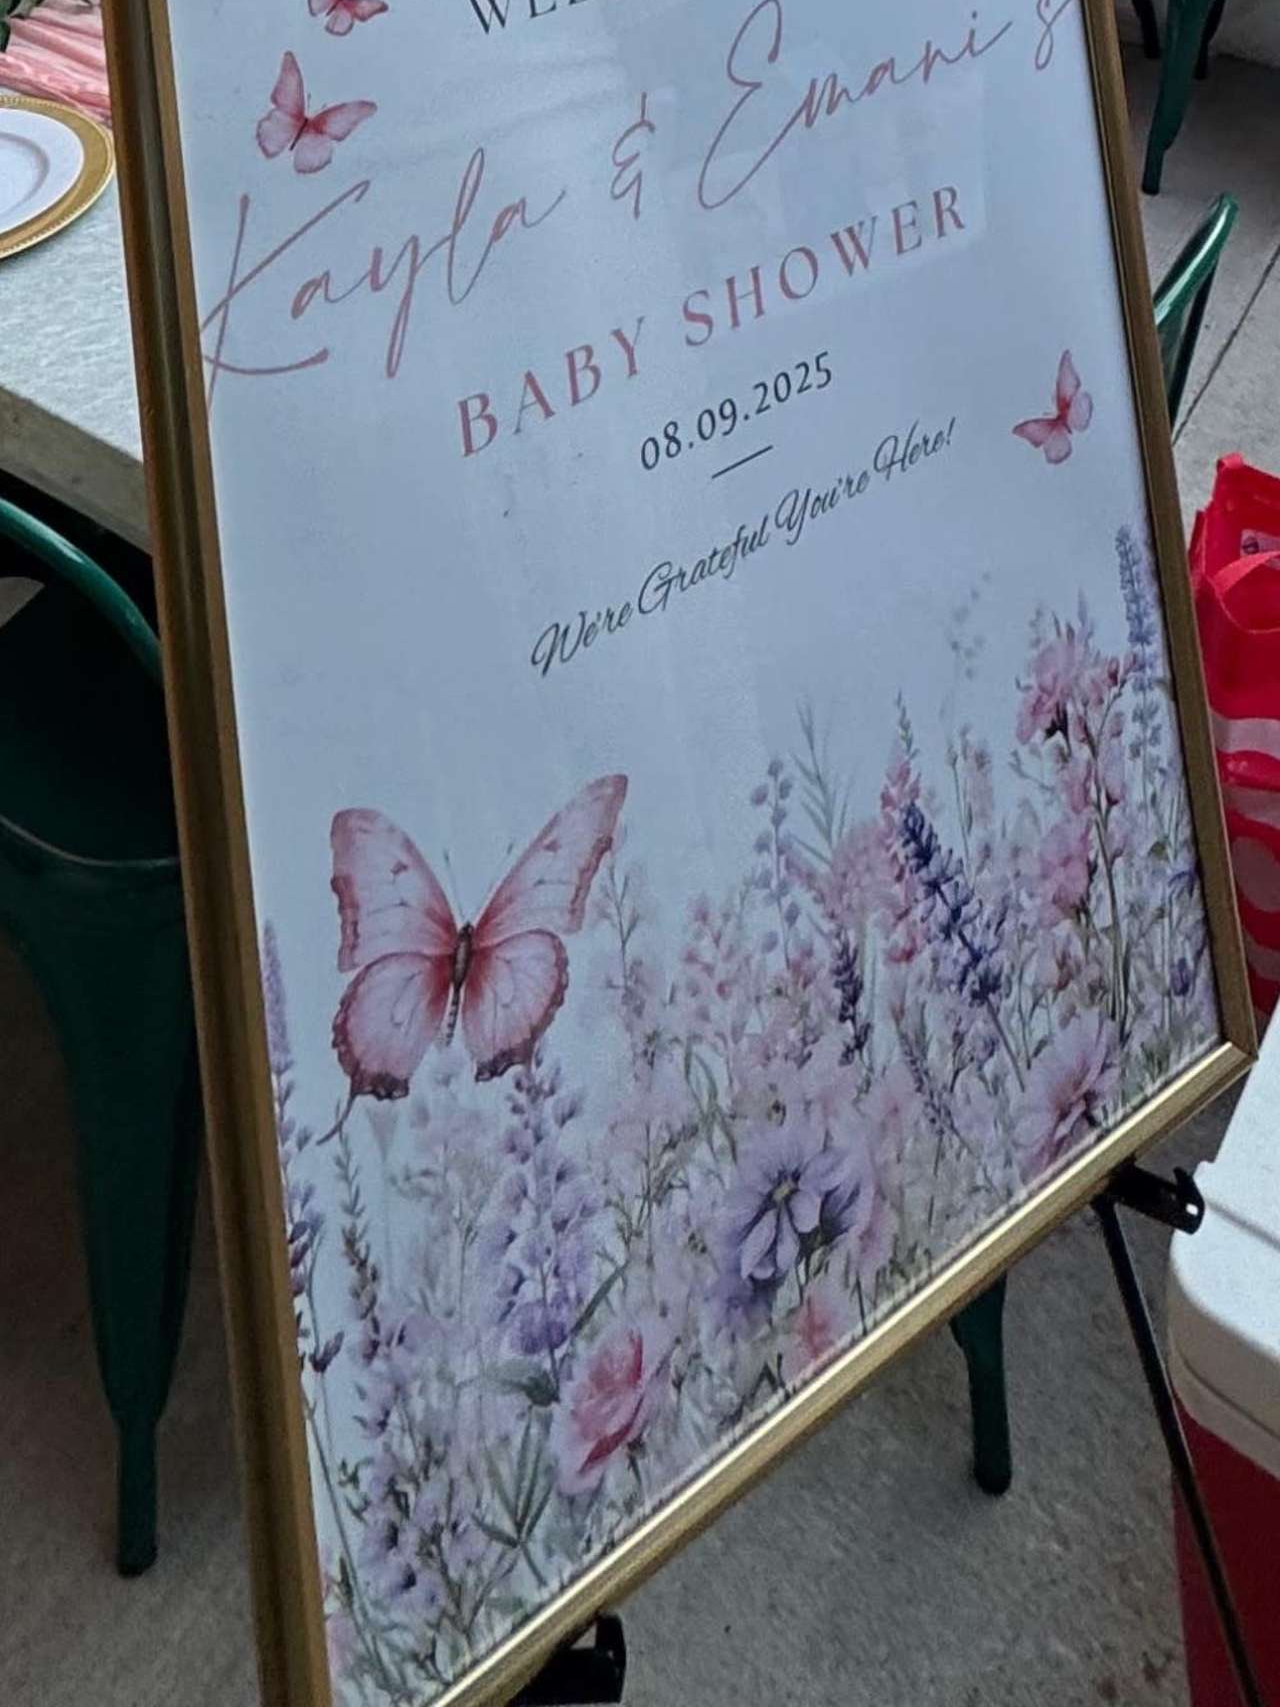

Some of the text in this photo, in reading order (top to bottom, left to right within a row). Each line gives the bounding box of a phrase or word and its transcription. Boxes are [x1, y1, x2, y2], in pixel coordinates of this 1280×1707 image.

[200, 147, 566, 413] Kayla
[610, 91, 656, 219] &
[456, 185, 966, 458] BABY SHOWER
[640, 350, 832, 471] 08.09.2025
[530, 416, 956, 678] We're Grateful You're Here!
